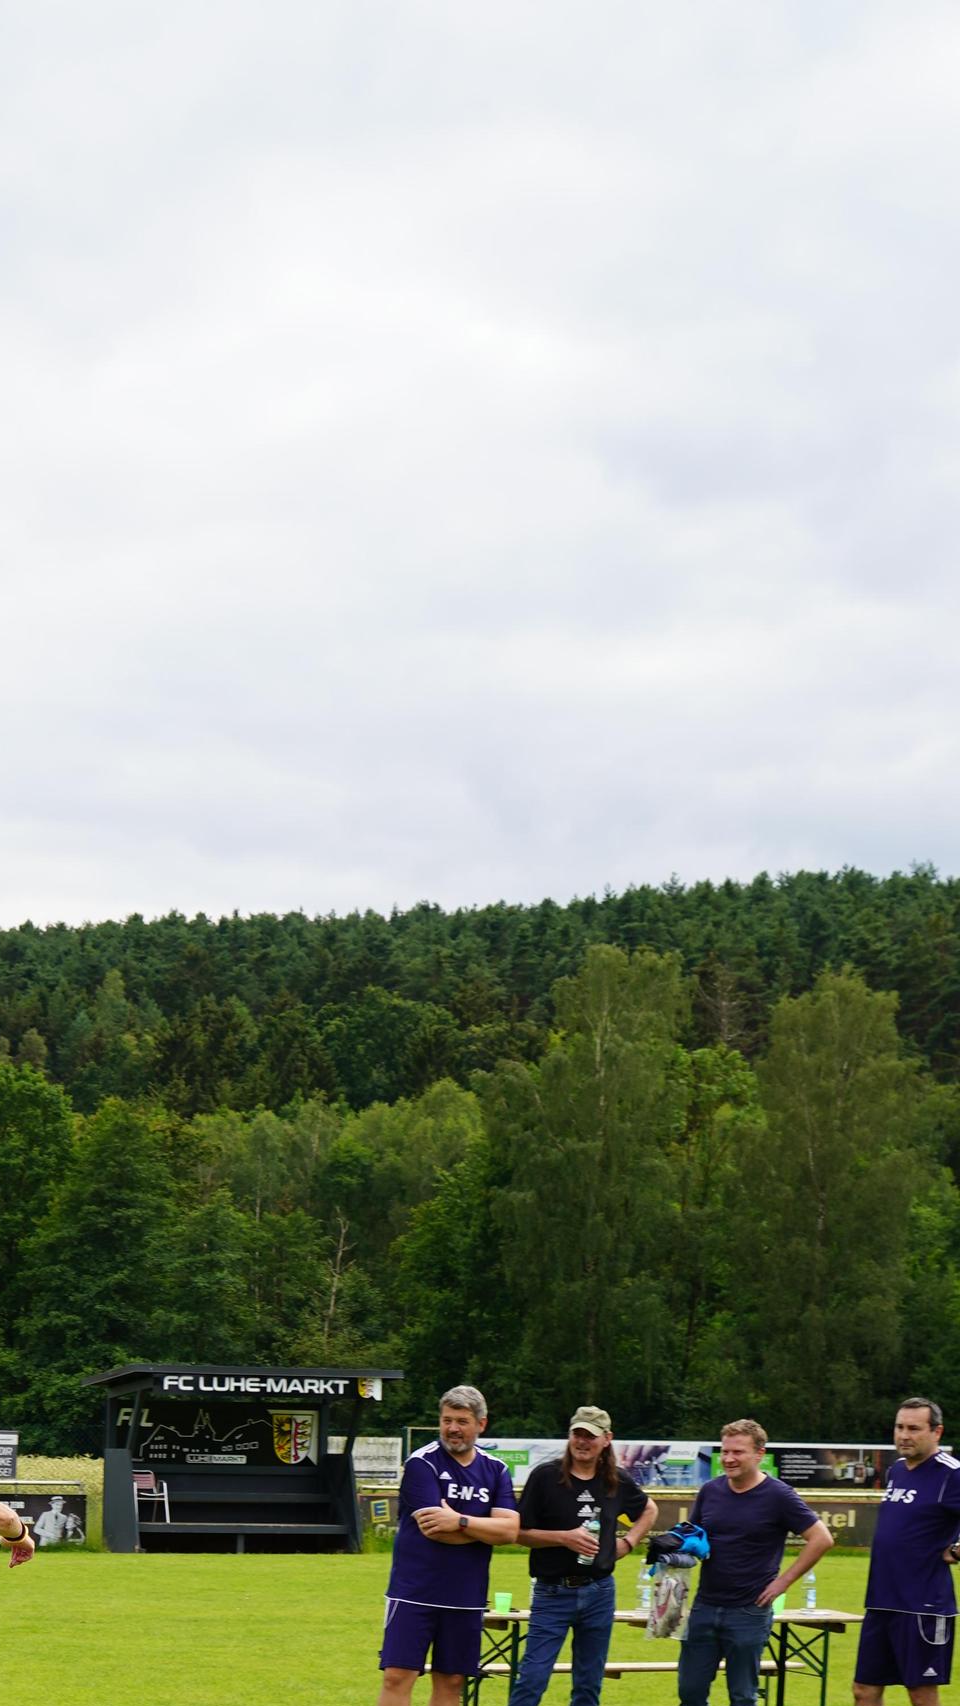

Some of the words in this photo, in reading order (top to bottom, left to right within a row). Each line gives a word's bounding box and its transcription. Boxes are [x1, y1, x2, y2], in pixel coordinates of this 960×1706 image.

[163, 1376, 194, 1391] FC
[199, 1376, 349, 1395] LUHE-MARKT
[447, 1483, 490, 1503] E-N-S
